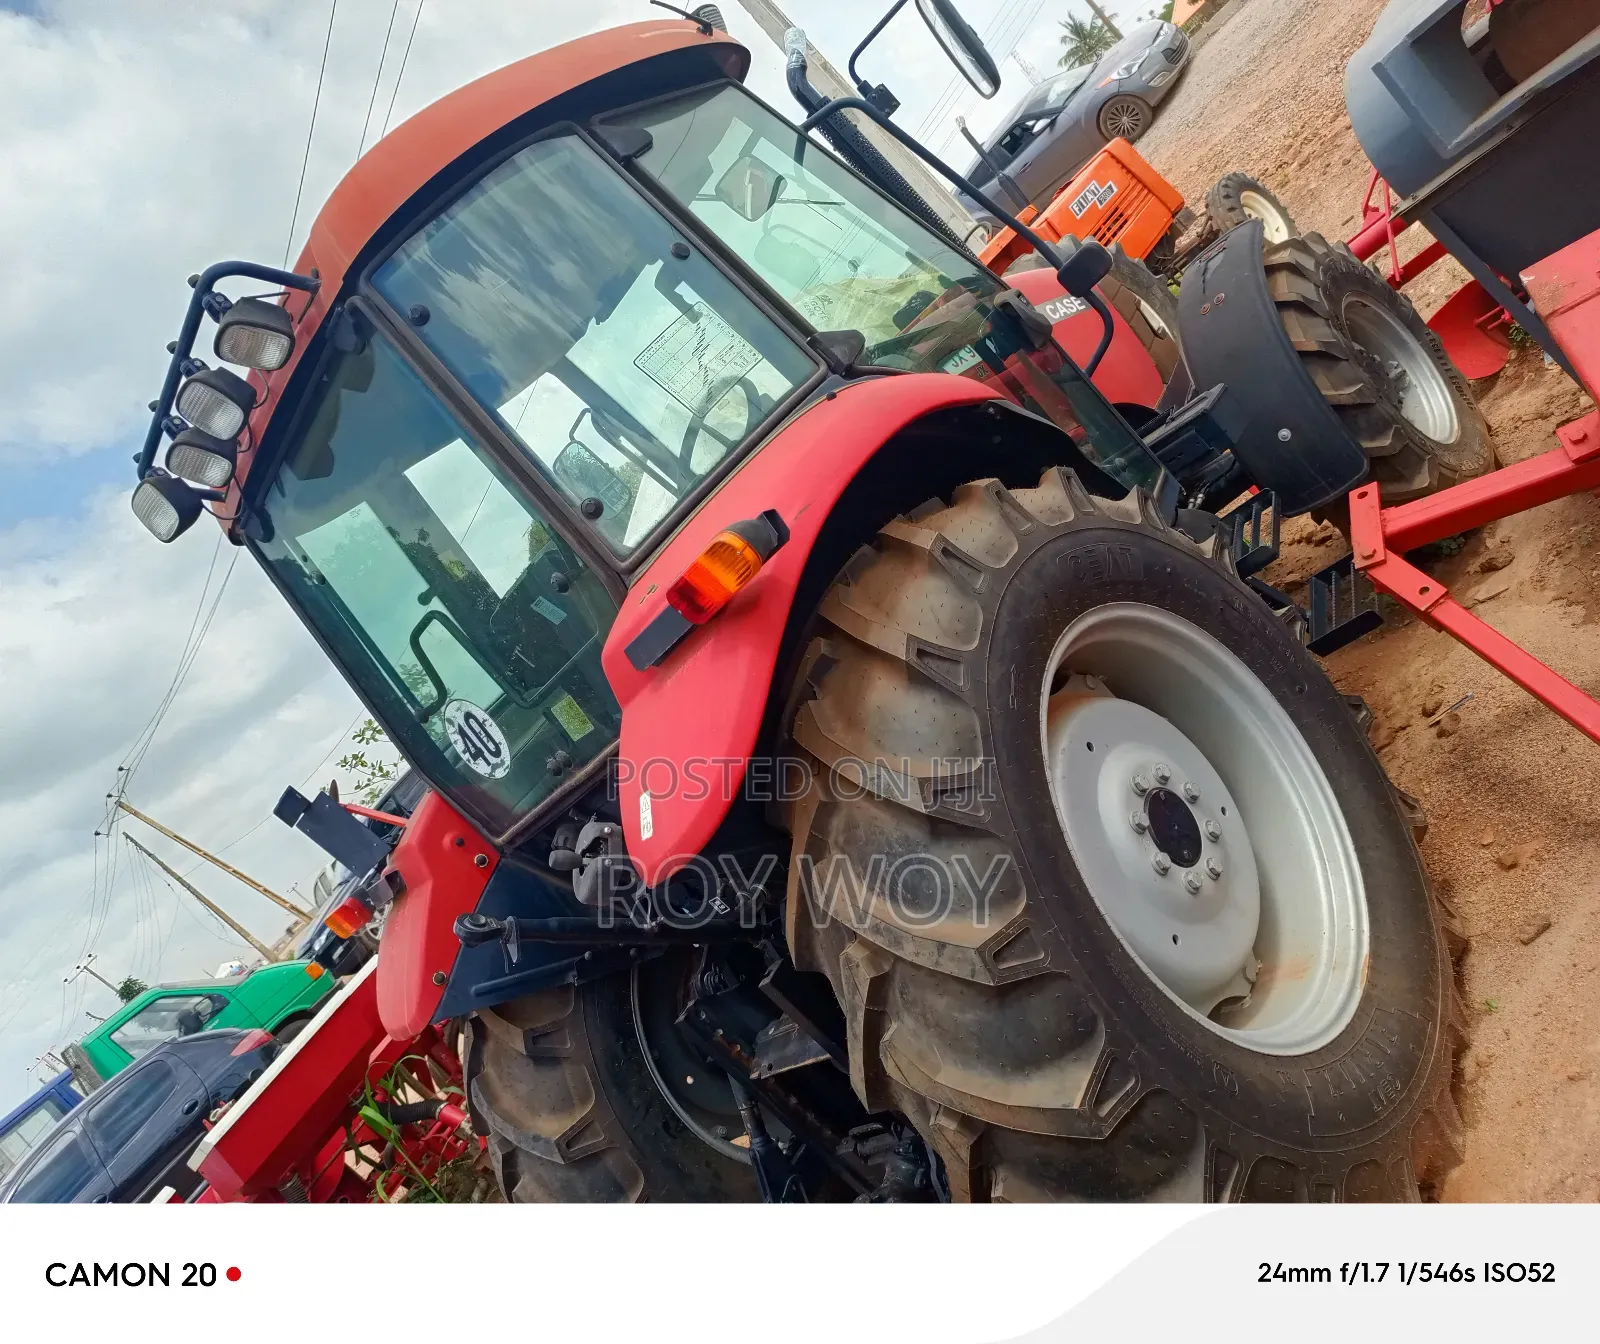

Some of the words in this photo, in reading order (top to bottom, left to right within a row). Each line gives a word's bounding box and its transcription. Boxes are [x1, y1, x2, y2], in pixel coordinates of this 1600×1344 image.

[1072, 182, 1100, 215] FIAT
[1045, 296, 1086, 319] CASE
[458, 711, 502, 767] 40
